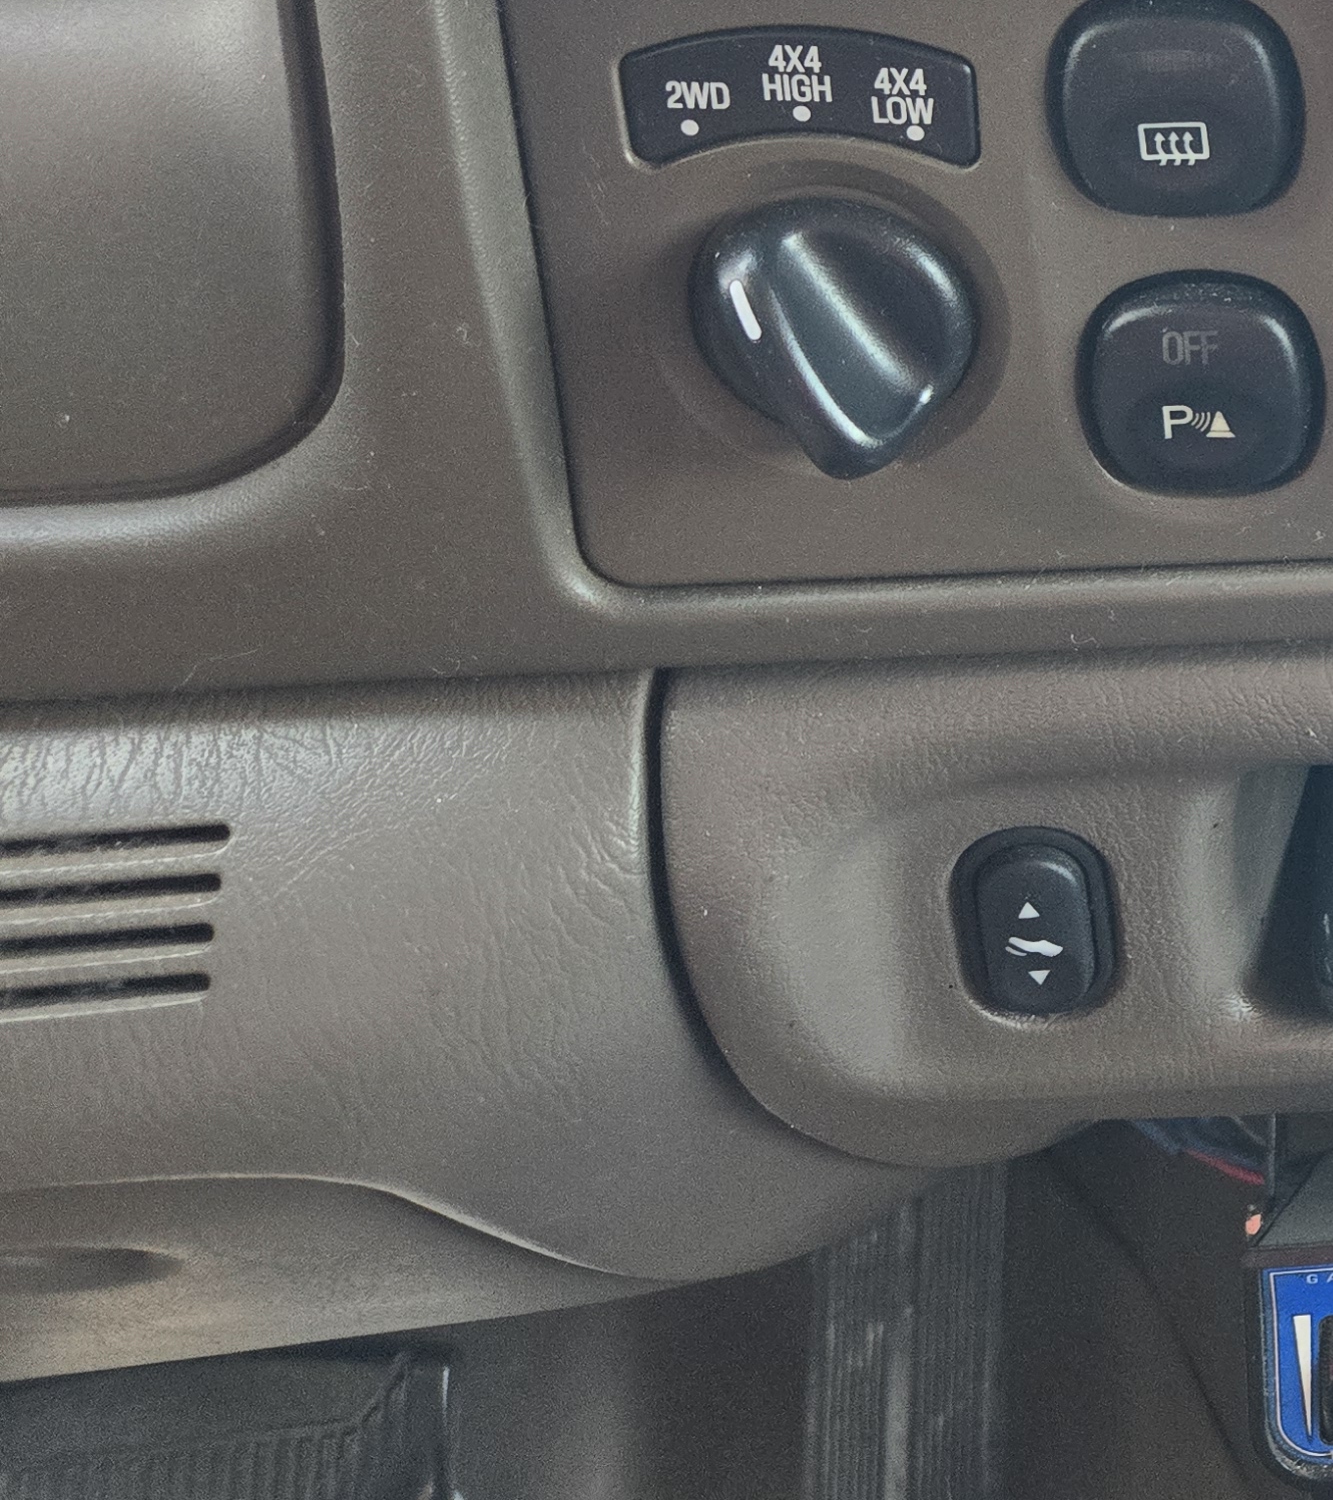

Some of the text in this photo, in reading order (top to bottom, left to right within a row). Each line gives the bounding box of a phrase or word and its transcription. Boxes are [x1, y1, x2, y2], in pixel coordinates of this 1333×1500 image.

[767, 44, 823, 73] 4X4
[664, 79, 731, 111] 2WD
[761, 74, 833, 104] HIGH
[873, 67, 928, 97] 4X4
[871, 96, 935, 126] LOW
[1160, 330, 1219, 366] OFF
